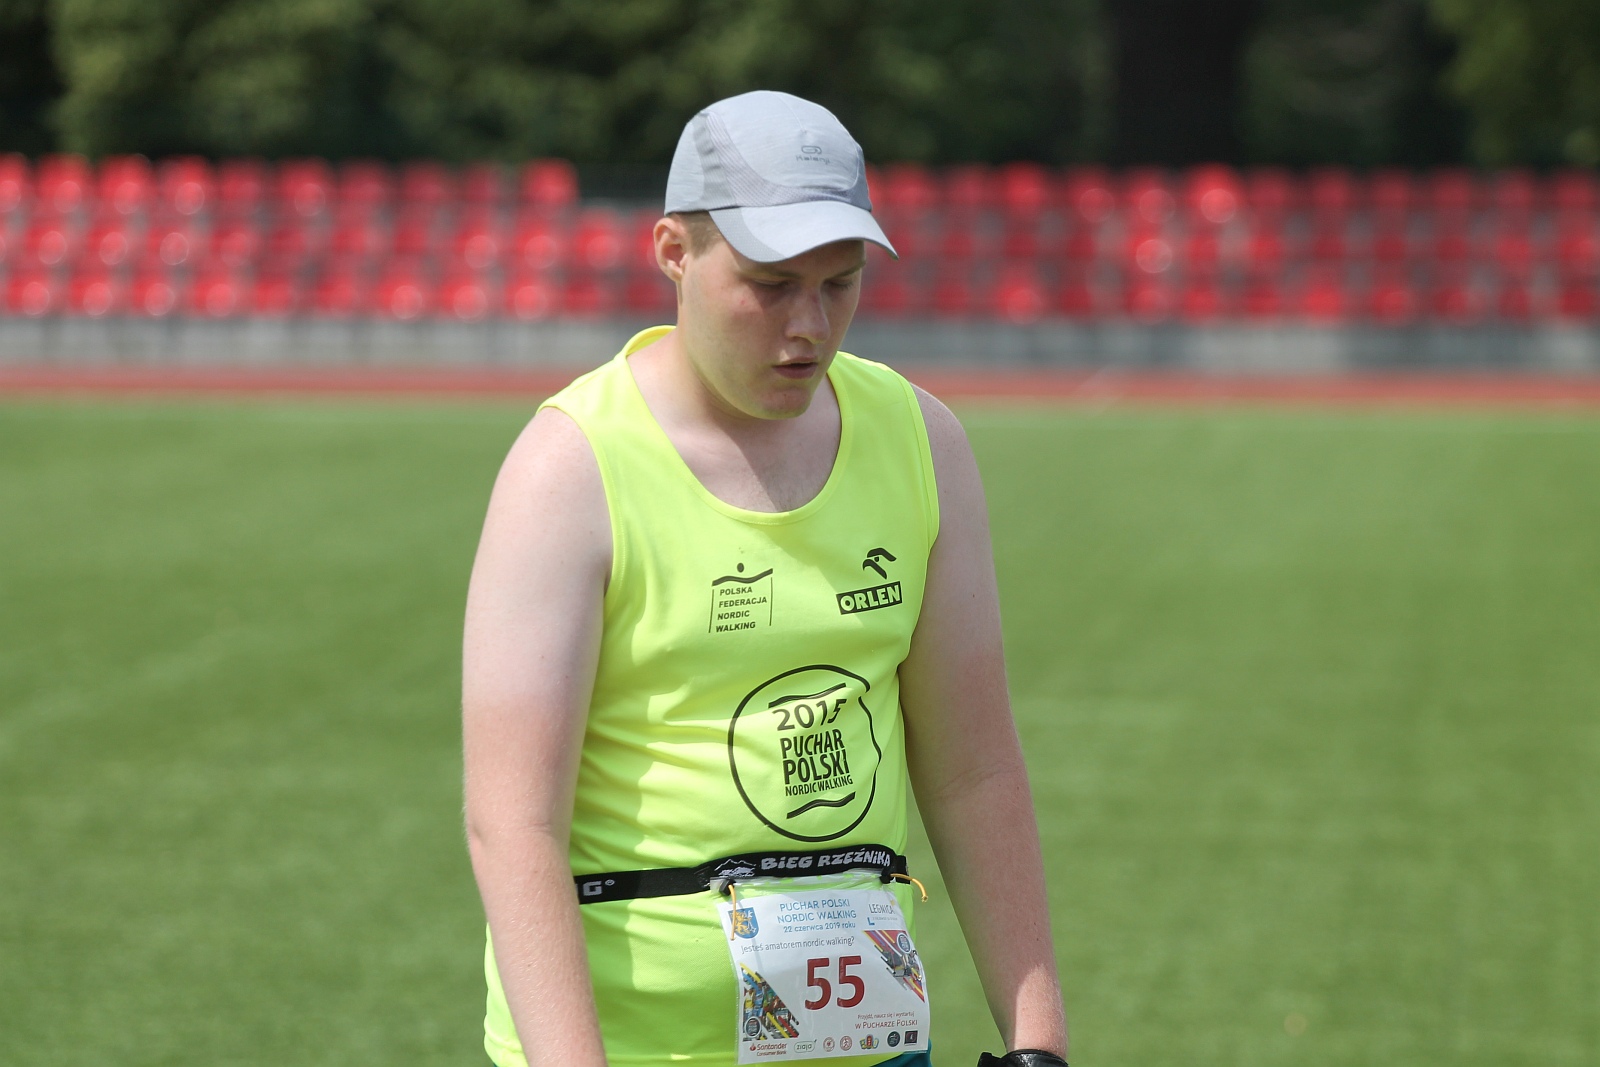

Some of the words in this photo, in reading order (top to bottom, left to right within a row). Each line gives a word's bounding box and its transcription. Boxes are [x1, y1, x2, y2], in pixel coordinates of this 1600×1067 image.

[719, 586, 753, 596] POLSKA
[840, 585, 901, 612] ORLEN
[718, 596, 767, 608] FEDERACJA
[717, 610, 750, 621] NORDIC
[715, 621, 756, 633] WALKING
[771, 698, 848, 731] 2015
[779, 728, 845, 760] PUCHAR
[782, 748, 850, 785] POLSKI
[785, 783, 817, 797] NORDIC
[817, 774, 854, 792] WALKING
[779, 900, 820, 912] PUCHAR
[821, 898, 851, 908] POLSKI
[777, 913, 815, 924] NORDIC
[816, 909, 857, 920] WALKING
[783, 926, 793, 934] 22
[794, 923, 824, 932] czerwca
[825, 921, 841, 930] 2019
[841, 920, 856, 929] roku
[765, 939, 803, 951] amatorem
[803, 938, 825, 948] nordic
[825, 936, 855, 947] walking?
[804, 955, 865, 1011] 55
[756, 1043, 787, 1051] Santander
